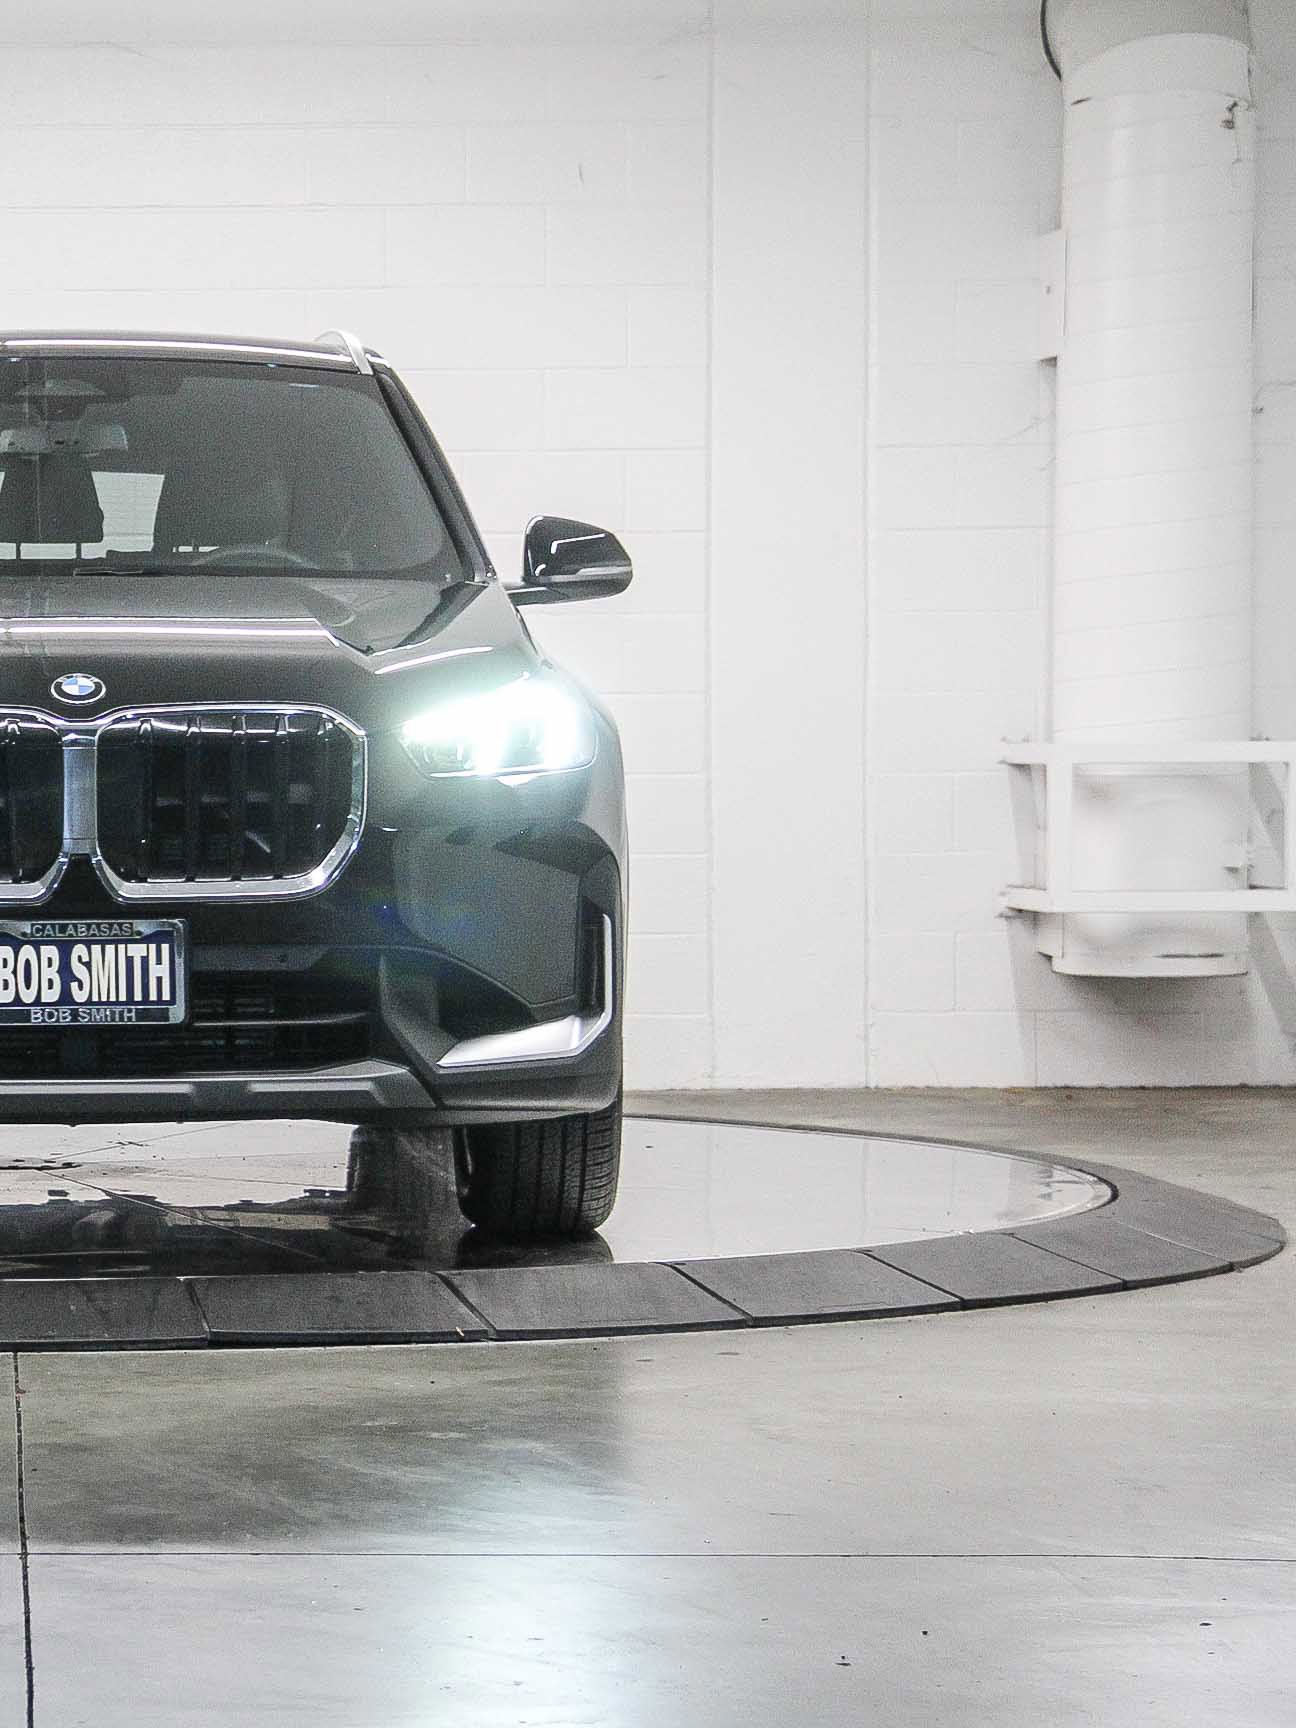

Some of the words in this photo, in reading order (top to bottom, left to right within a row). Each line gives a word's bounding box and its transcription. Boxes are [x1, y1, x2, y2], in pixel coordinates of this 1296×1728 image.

[31, 924, 133, 937] CALABASAS
[70, 944, 170, 1002] SMITH
[30, 1008, 71, 1022] BOB
[77, 1008, 136, 1022] SMITH
